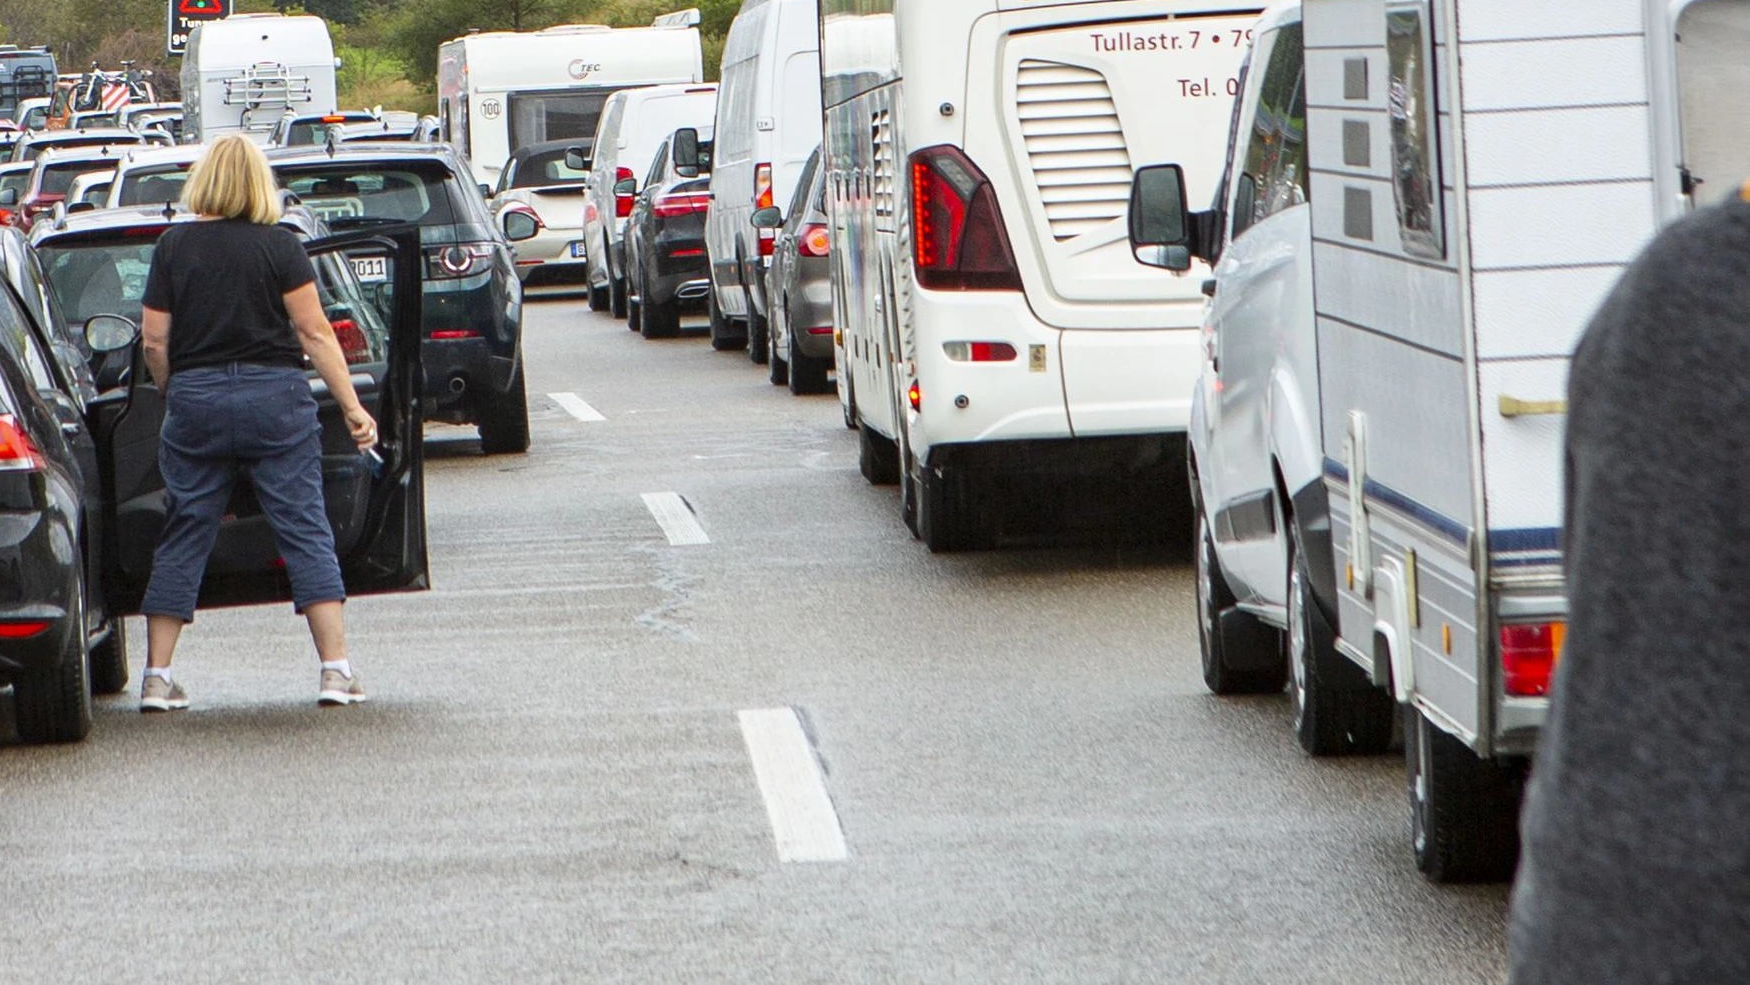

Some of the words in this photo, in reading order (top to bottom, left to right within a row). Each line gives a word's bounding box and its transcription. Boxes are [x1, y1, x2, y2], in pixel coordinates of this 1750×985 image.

[1091, 32, 1182, 51] Tullastr.
[1189, 31, 1200, 49] 7
[1177, 79, 1217, 97] Tel.
[482, 103, 500, 115] 100
